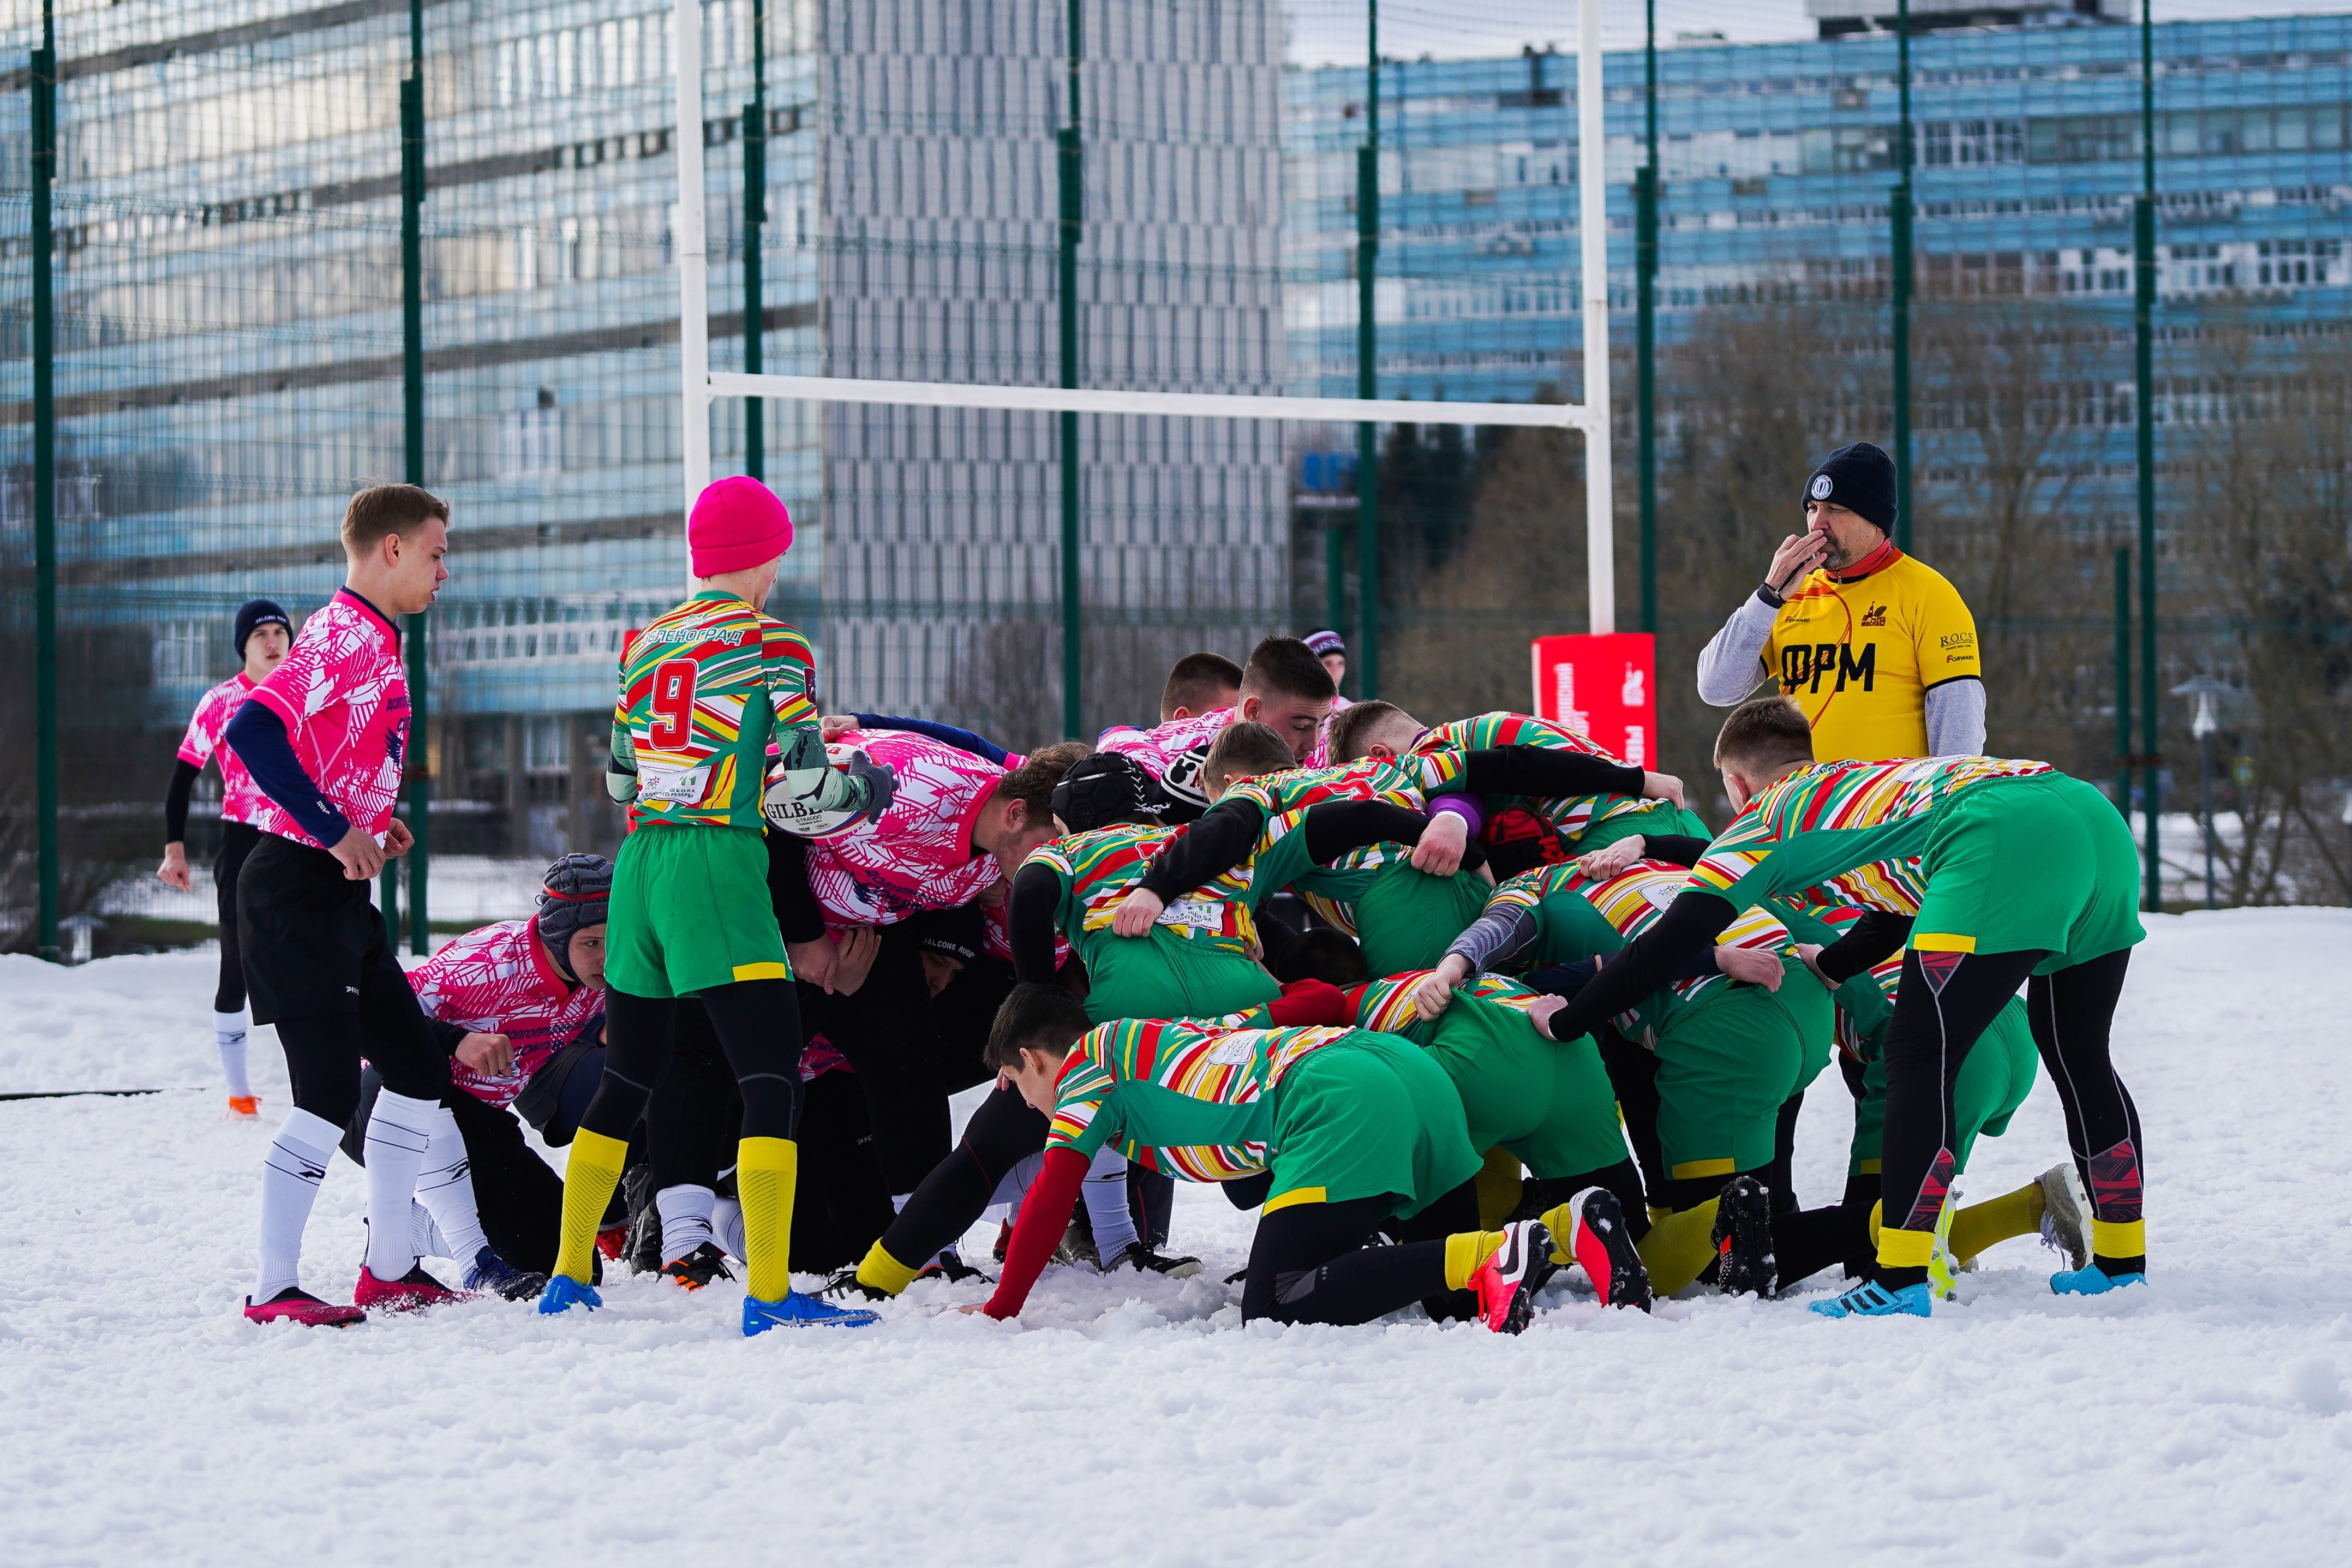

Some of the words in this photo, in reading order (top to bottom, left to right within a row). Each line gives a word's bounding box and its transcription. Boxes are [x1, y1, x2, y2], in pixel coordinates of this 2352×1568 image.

[642, 627, 745, 646] ЗЕЛЕНОГРАД
[1947, 655, 1974, 663] FORWARD
[1782, 643, 1876, 695] ФРМ
[650, 658, 699, 751] 9
[924, 938, 956, 950] FALCONS
